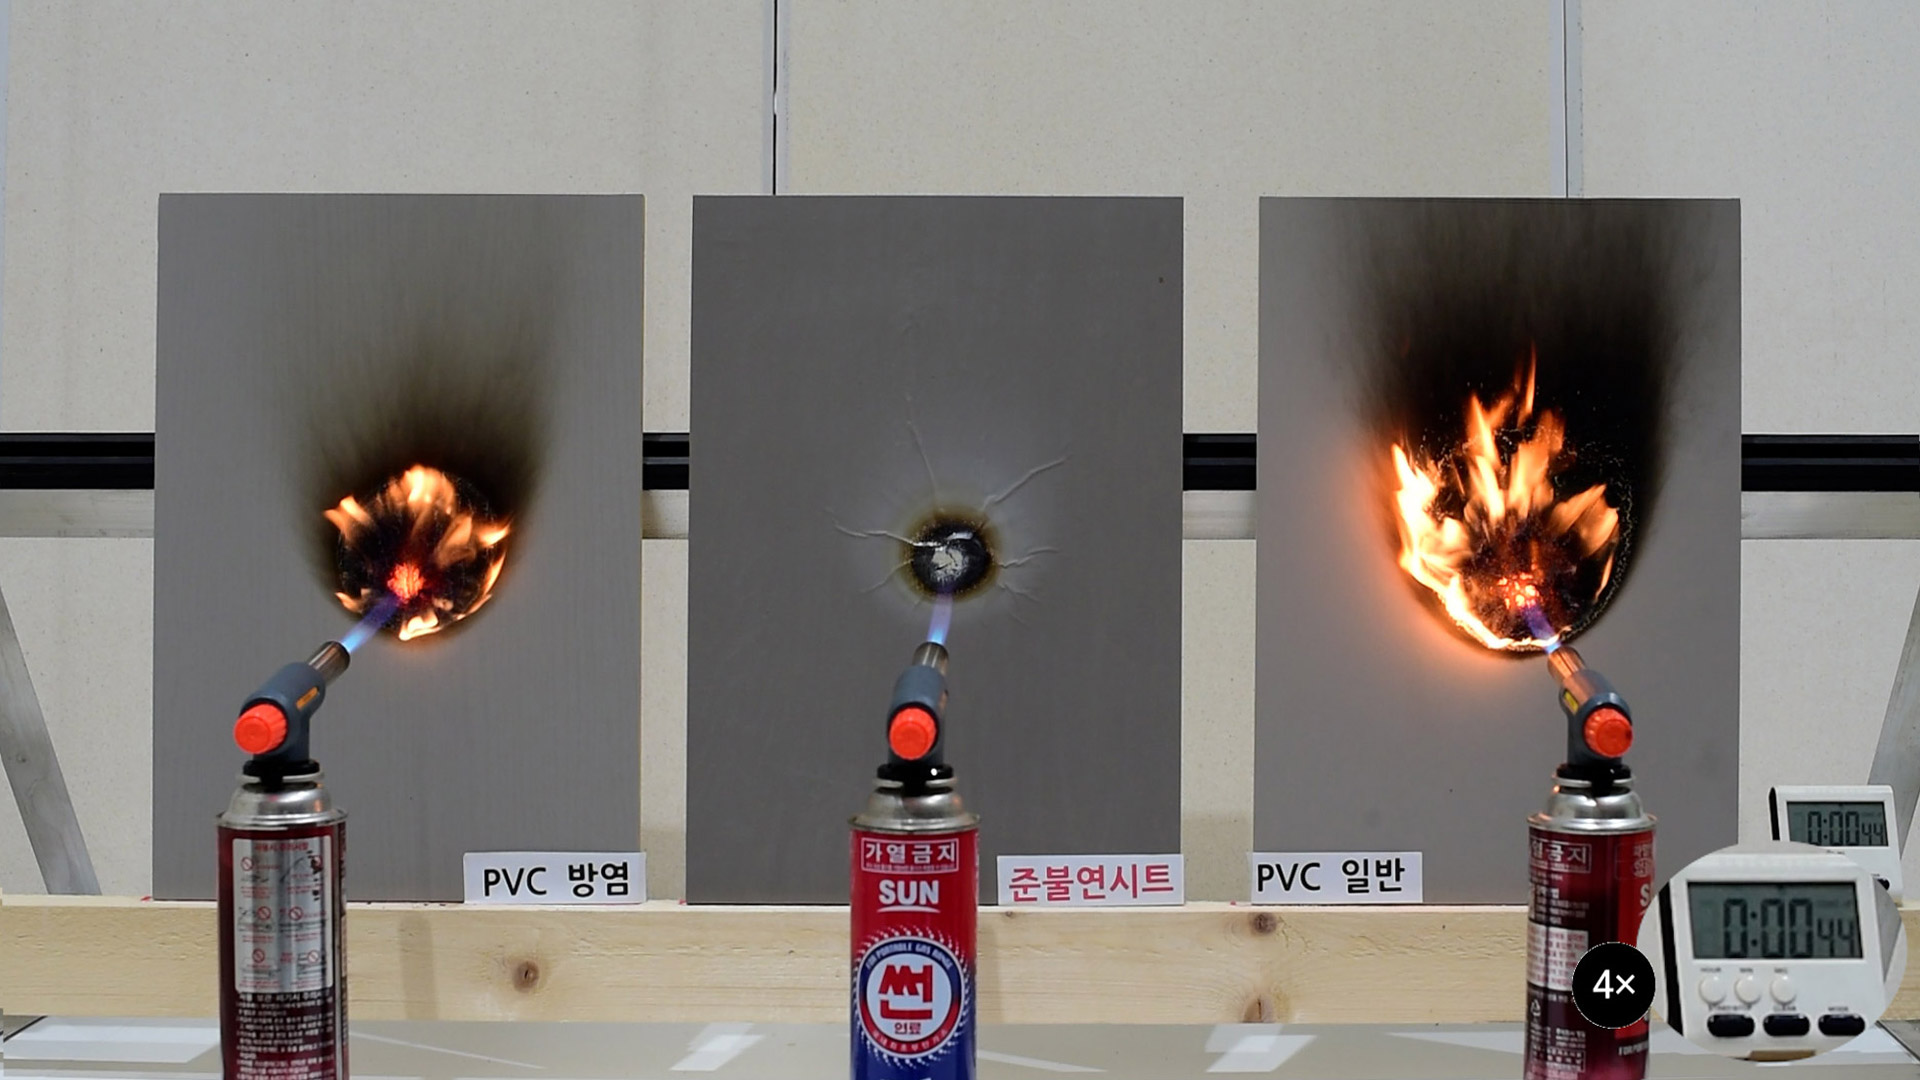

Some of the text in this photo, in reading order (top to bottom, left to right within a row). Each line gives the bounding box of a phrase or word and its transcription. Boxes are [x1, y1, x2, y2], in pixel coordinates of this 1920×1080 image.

[865, 842, 956, 864] 가열금지
[483, 861, 628, 898] PVC 방염
[878, 879, 939, 905] SUN
[1008, 863, 1174, 902] 준불연시트
[1257, 857, 1405, 894] PVC 일반
